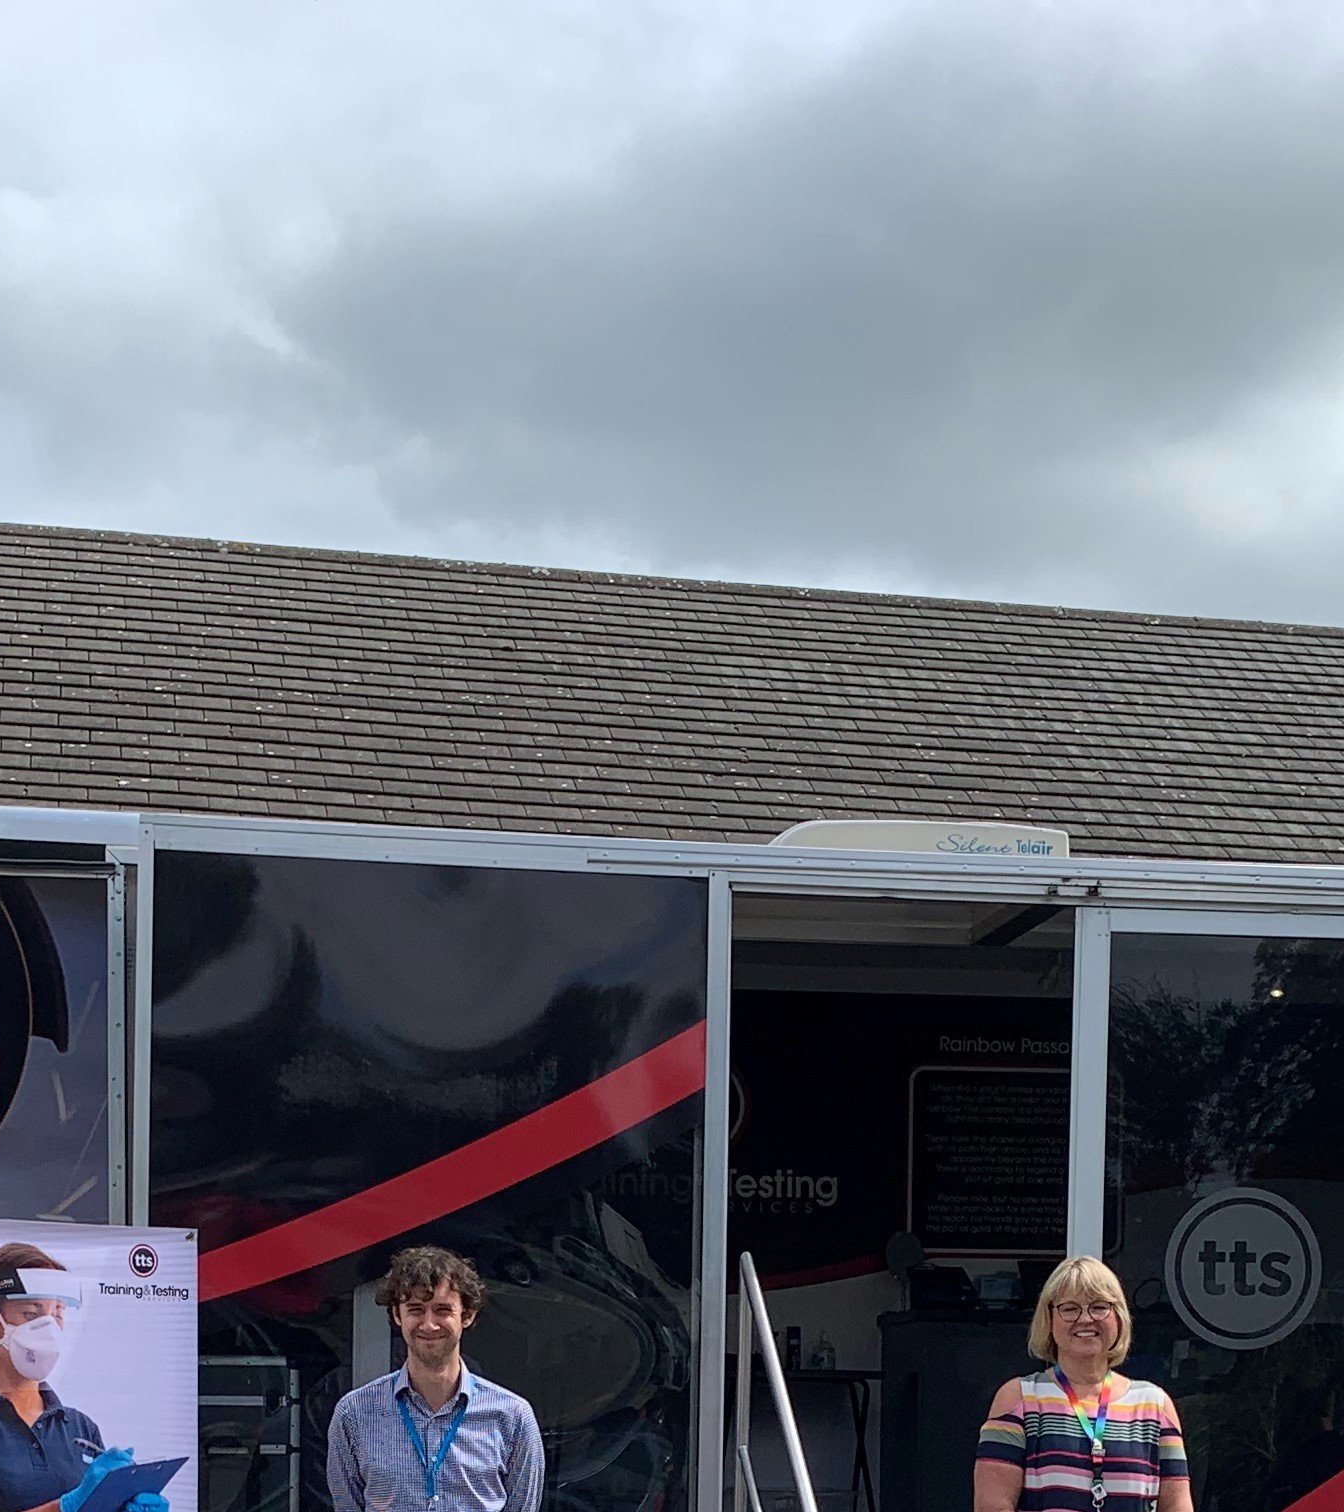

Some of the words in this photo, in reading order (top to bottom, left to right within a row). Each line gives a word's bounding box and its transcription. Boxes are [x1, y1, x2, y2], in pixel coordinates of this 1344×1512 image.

[1016, 839, 1054, 855] Telair
[939, 1035, 1016, 1053] Rainbow
[1020, 1037, 1070, 1055] Passa
[134, 1253, 154, 1268] tts
[1199, 1240, 1292, 1298] tts
